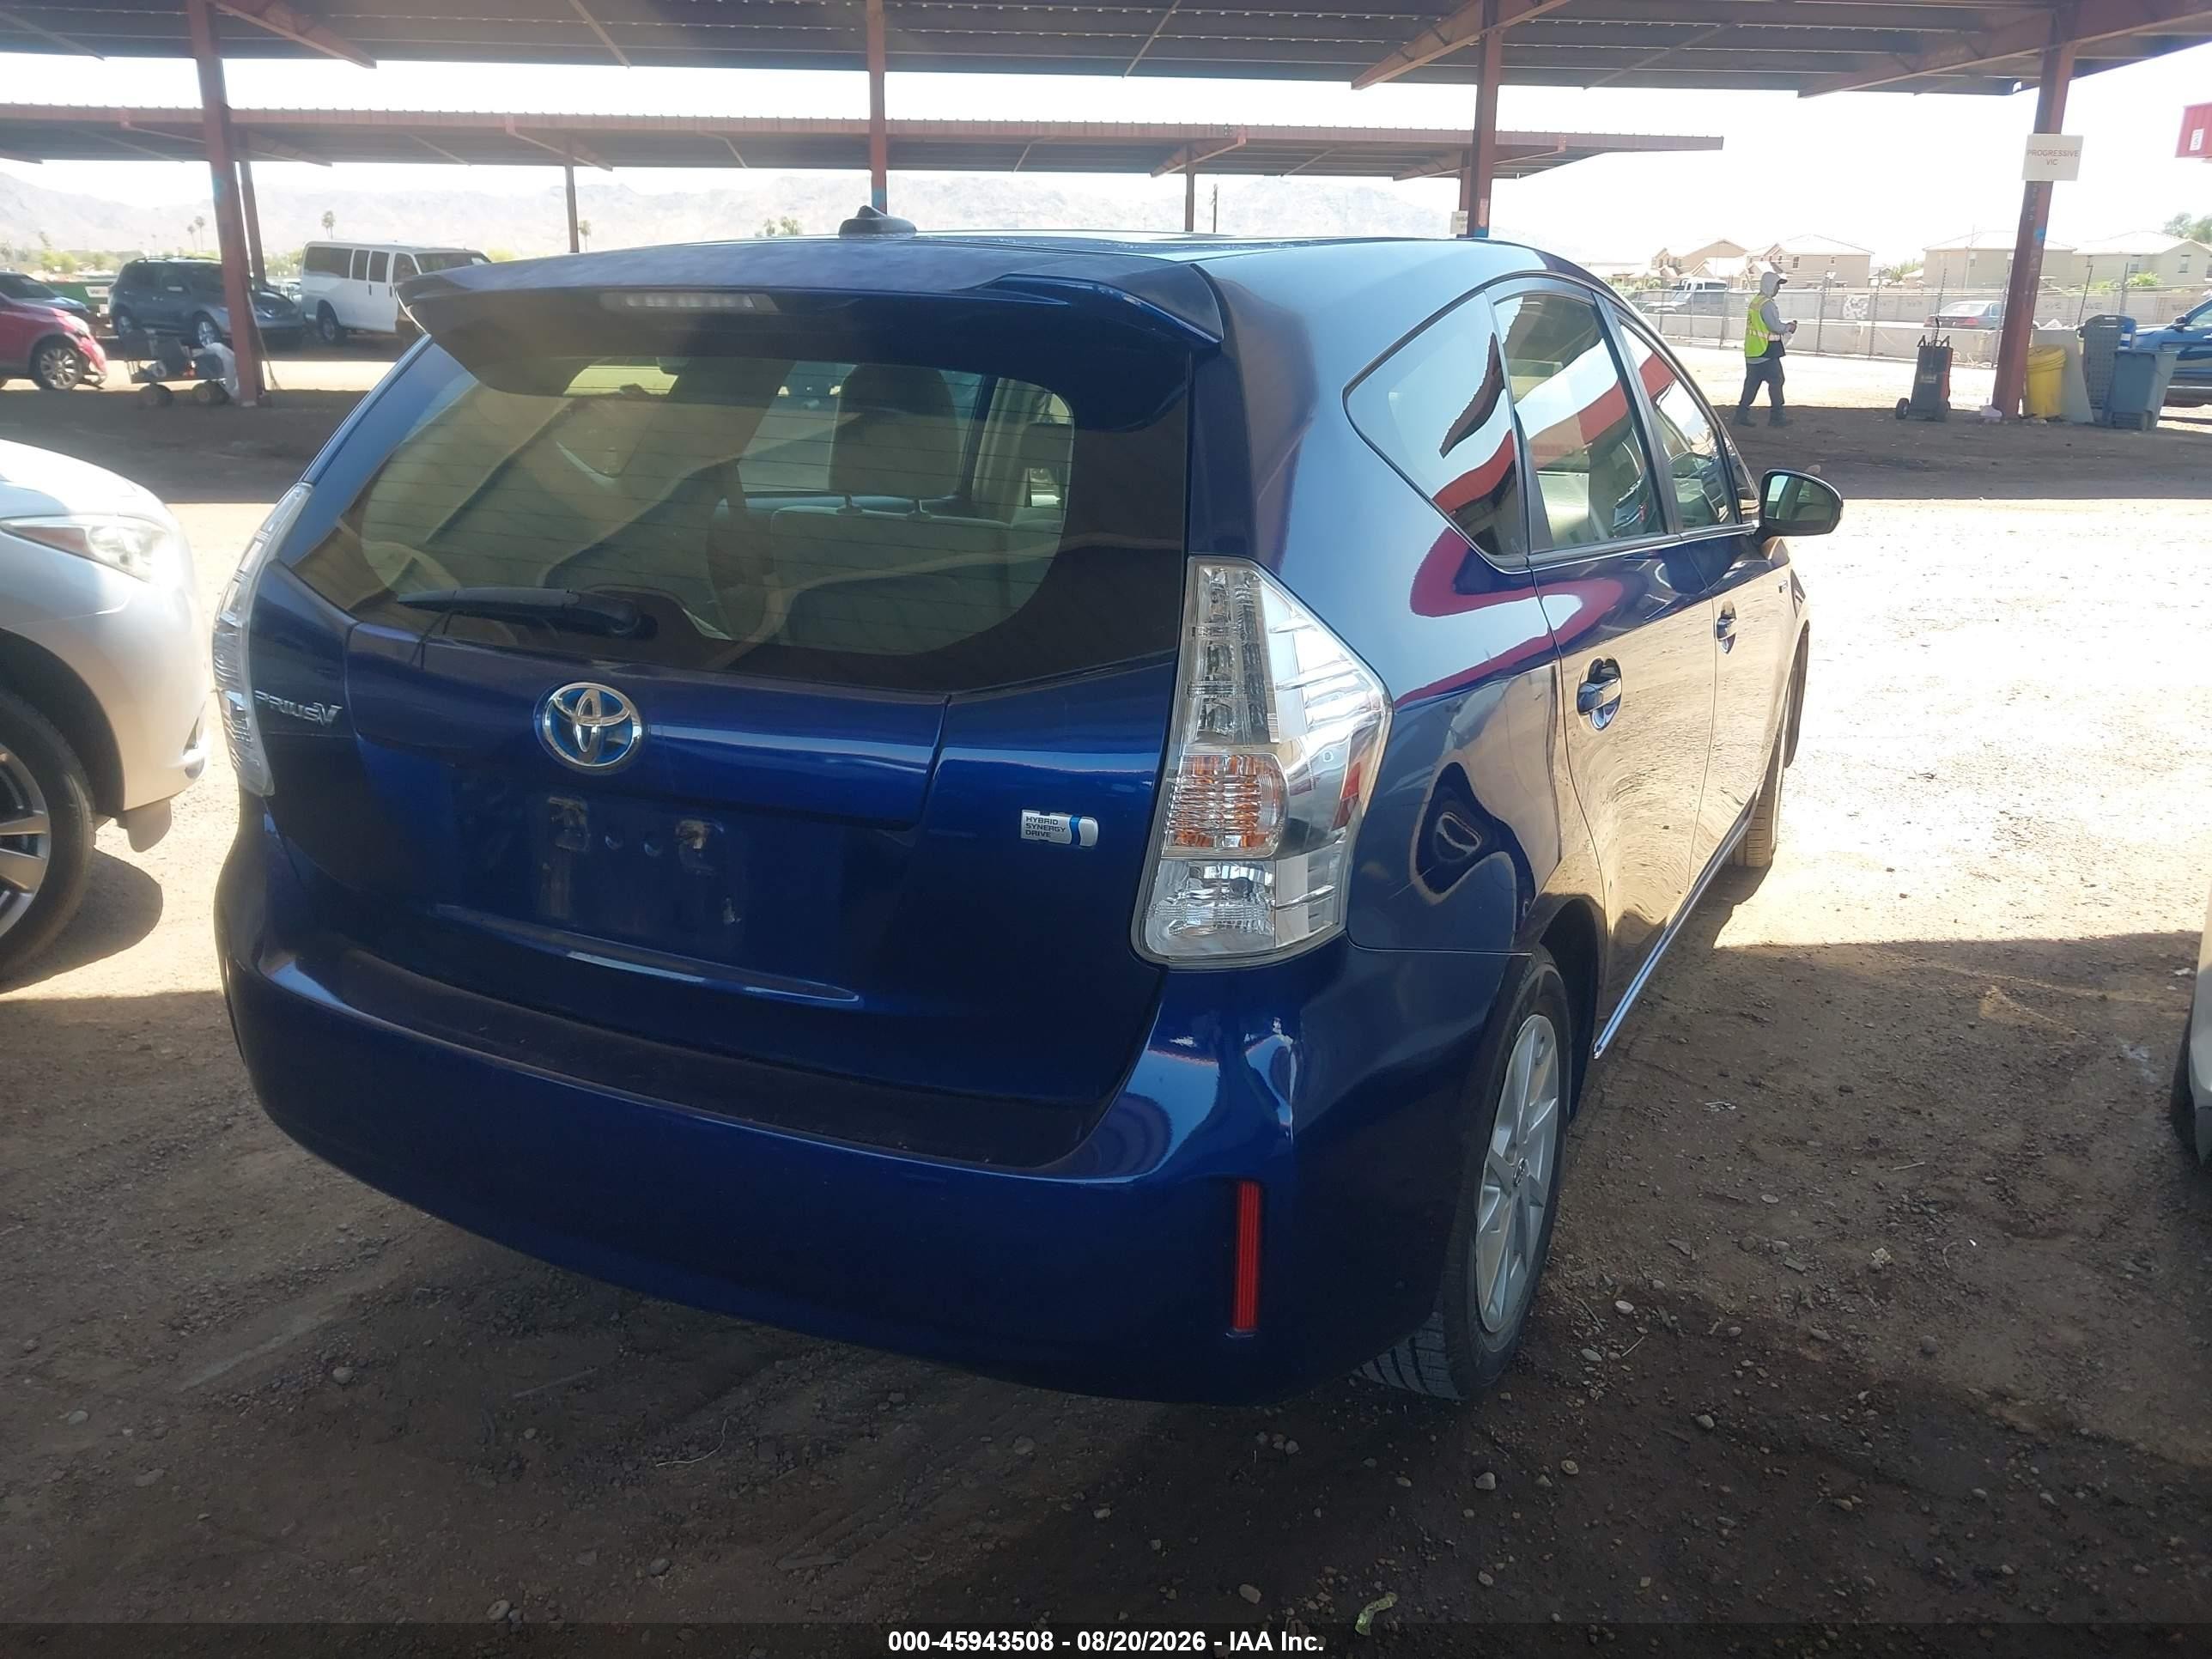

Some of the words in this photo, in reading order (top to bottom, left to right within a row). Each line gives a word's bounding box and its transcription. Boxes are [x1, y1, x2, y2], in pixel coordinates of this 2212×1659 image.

[1025, 816, 1059, 825] HYBRID
[1025, 823, 1066, 833] SYNERGY
[1025, 830, 1052, 838] DRIVE
